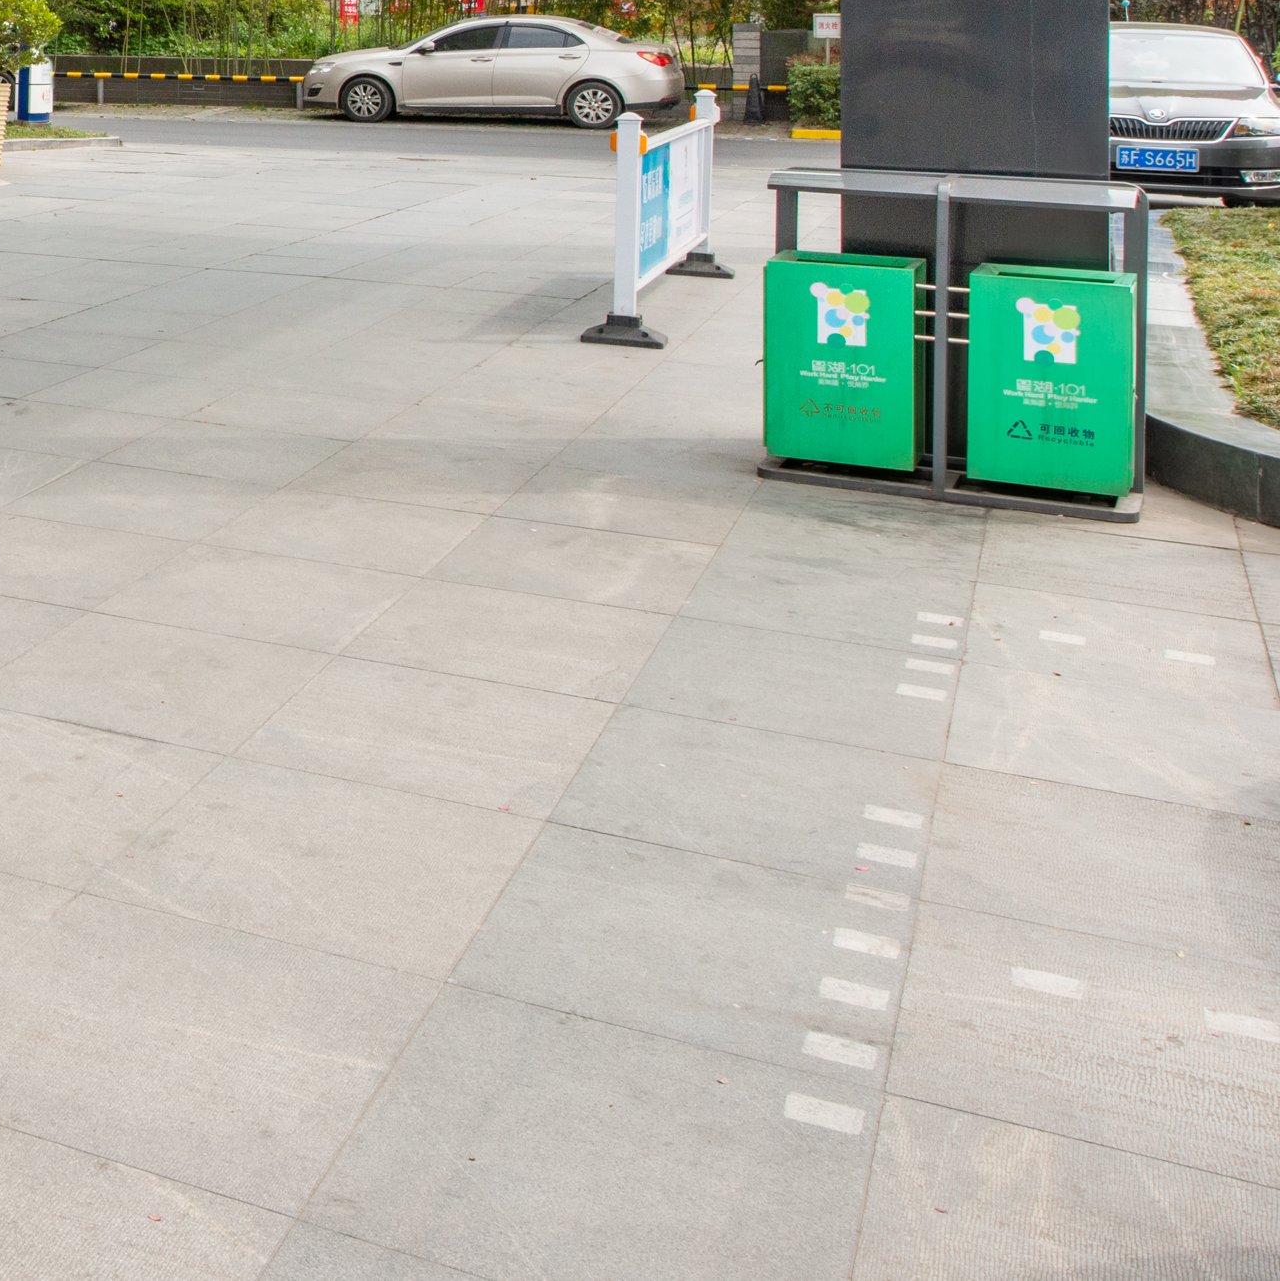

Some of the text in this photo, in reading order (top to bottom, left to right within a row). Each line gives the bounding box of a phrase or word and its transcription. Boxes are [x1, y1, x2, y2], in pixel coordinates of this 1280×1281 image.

[1040, 423, 1095, 440] 可回收物
[1038, 434, 1095, 447] Recyclable
